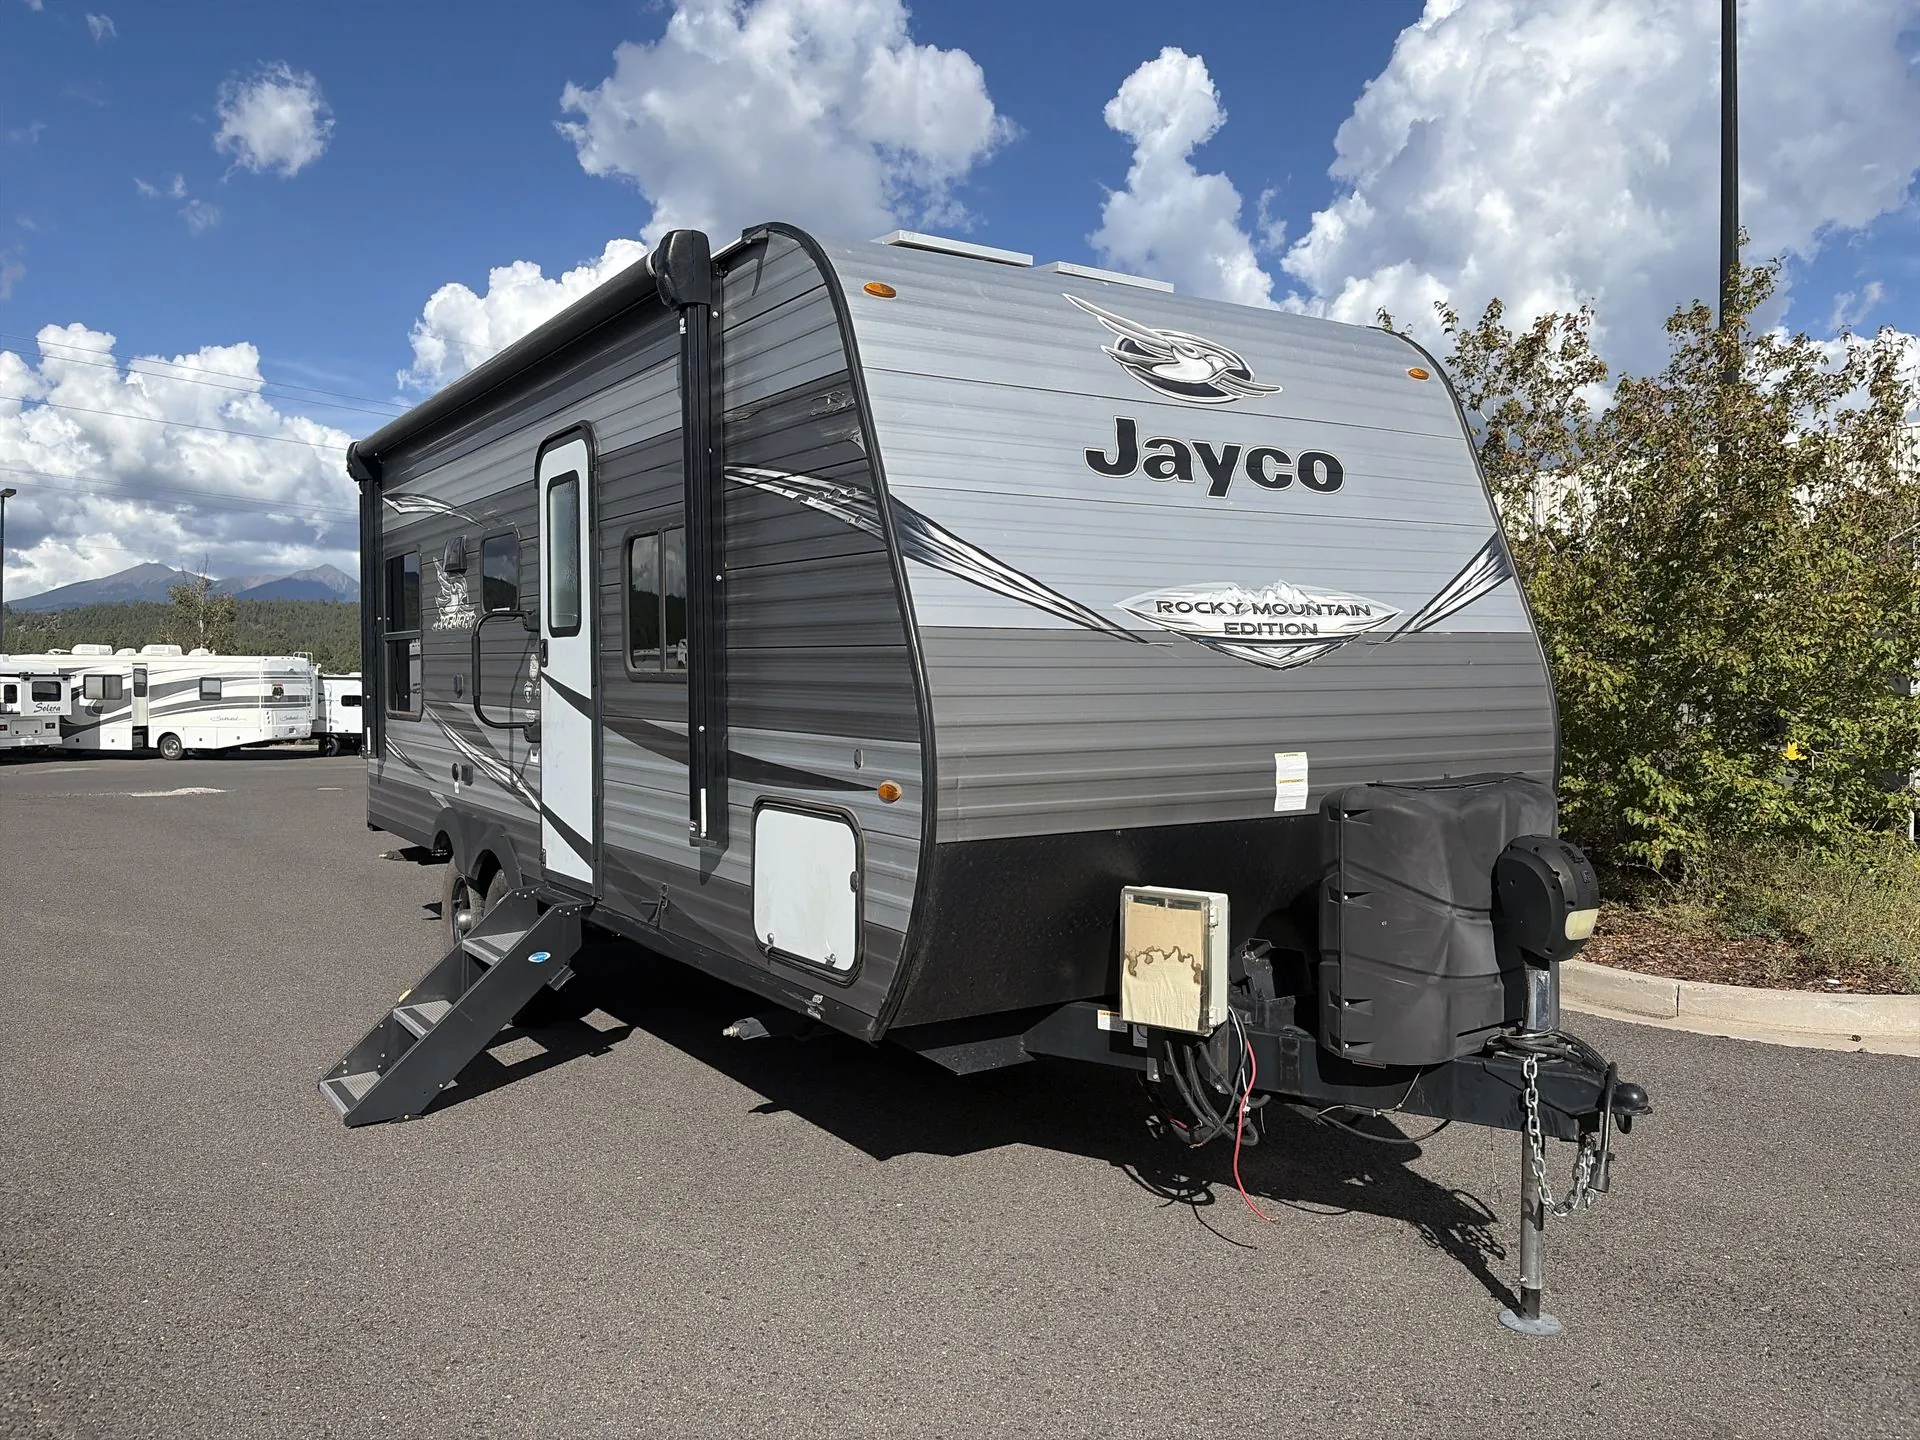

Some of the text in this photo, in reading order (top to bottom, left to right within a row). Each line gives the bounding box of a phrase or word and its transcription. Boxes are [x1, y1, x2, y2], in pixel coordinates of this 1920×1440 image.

[1085, 416, 1345, 497] Jayco
[1156, 600, 1371, 616] ROCKY MOUNTAIN
[1224, 622, 1318, 636] EDITION
[33, 702, 61, 713] Solera
